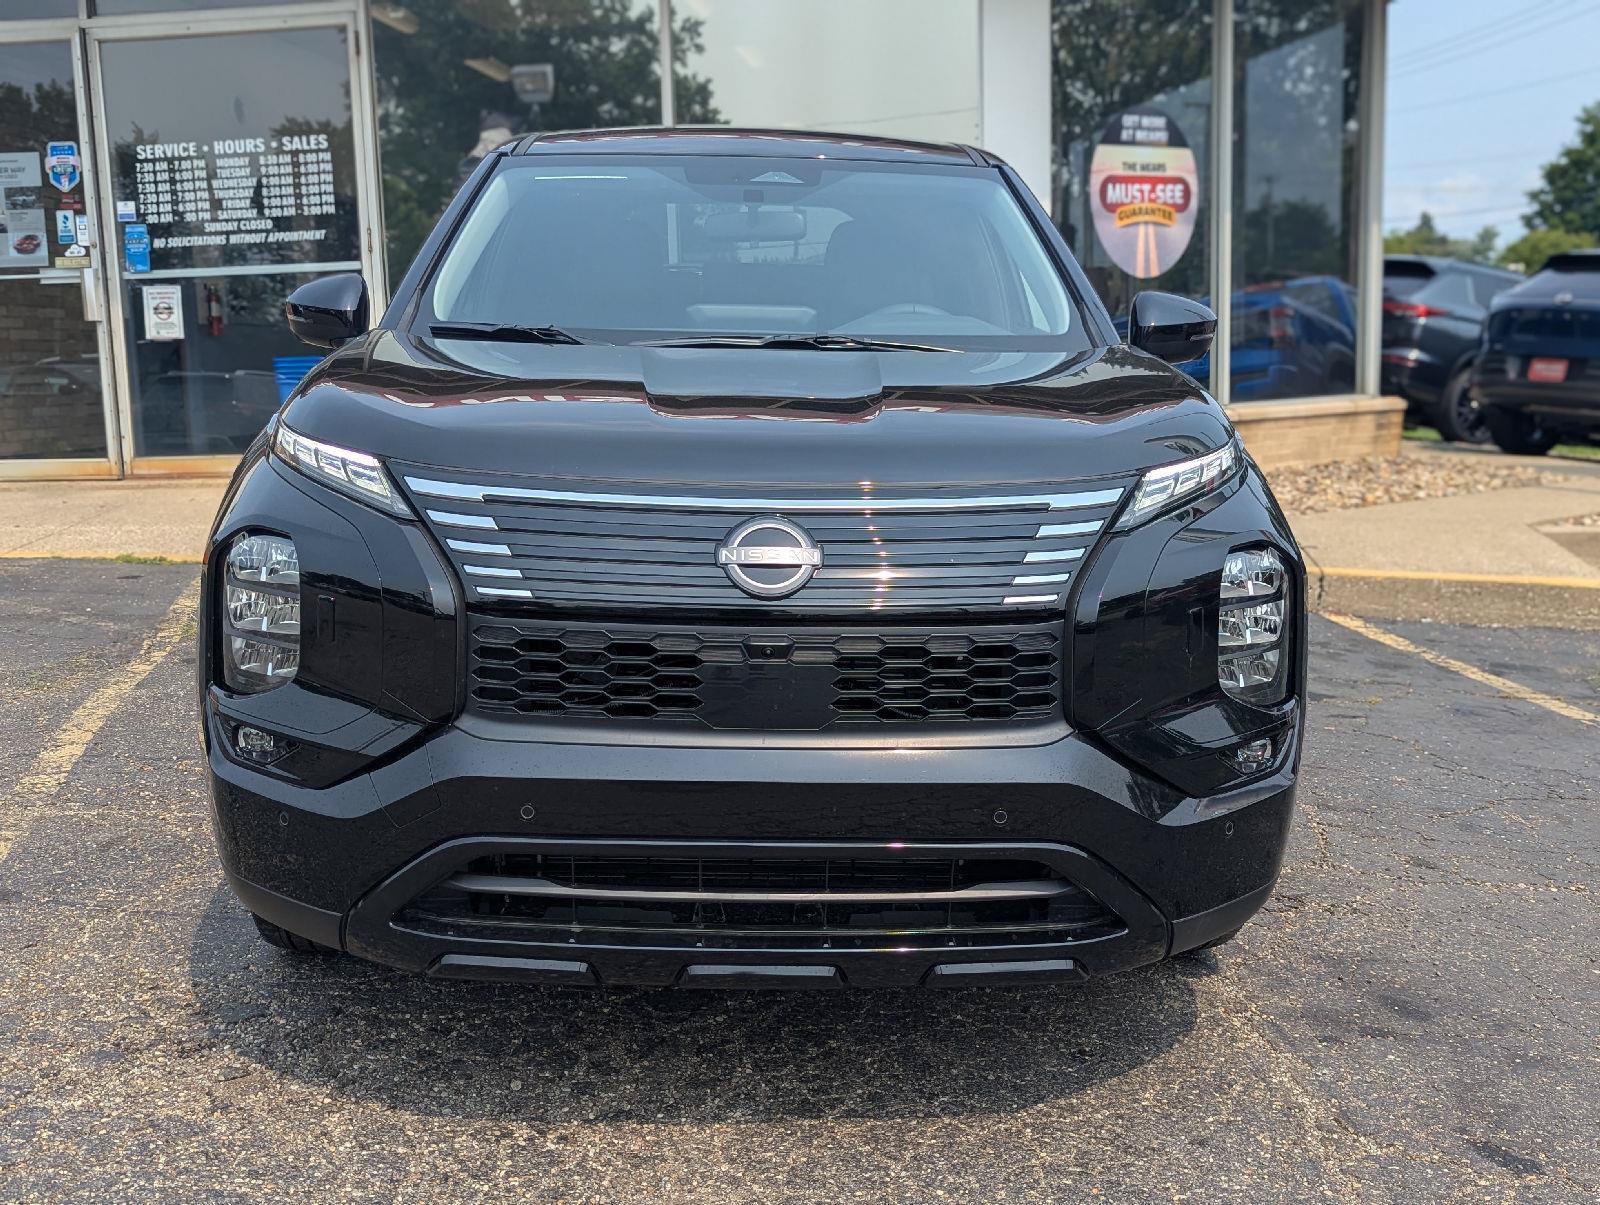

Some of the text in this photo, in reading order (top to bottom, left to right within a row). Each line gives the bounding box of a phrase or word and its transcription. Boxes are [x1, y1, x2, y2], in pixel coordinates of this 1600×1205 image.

[136, 134, 328, 159] SERVICE HOURS SALES
[155, 161, 168, 170] AM
[193, 159, 206, 169] PM
[216, 157, 249, 167] MONDAY
[279, 154, 291, 163] AM
[318, 152, 331, 161] PM
[1122, 162, 1137, 172] THE
[156, 172, 169, 181] AM
[194, 170, 207, 179] PM
[217, 167, 250, 178] TUESDAY
[280, 164, 293, 173] AM
[319, 162, 333, 172] PM
[157, 182, 170, 192] AM
[195, 180, 208, 190] PM
[211, 177, 257, 188] WEDNESDAY
[280, 175, 293, 184] AM
[320, 173, 333, 183] PM
[159, 193, 171, 202] AM
[196, 190, 209, 200] PM
[214, 188, 254, 199] THURSDAY
[281, 186, 294, 195] AM
[320, 184, 334, 193] PM
[1107, 183, 1184, 204] MUST-SEE
[159, 203, 172, 212] AM
[197, 201, 210, 211] PM
[222, 199, 250, 208] FRIDAY
[282, 196, 295, 206] AM
[322, 194, 335, 203] PM
[160, 213, 173, 223] AM
[198, 211, 211, 220] PM
[217, 208, 257, 219] SATURDAY
[283, 207, 296, 216] AM
[322, 204, 335, 214] PM
[1117, 208, 1173, 222] GUARANTEE
[204, 219, 273, 232] SUNDAY CLOSED
[152, 238, 166, 248] NO
[167, 235, 227, 248] SOLICITATIONS
[229, 232, 267, 244] WITHOUT
[267, 230, 327, 242] APPOINTMENT
[722, 549, 818, 562] NISSAN
